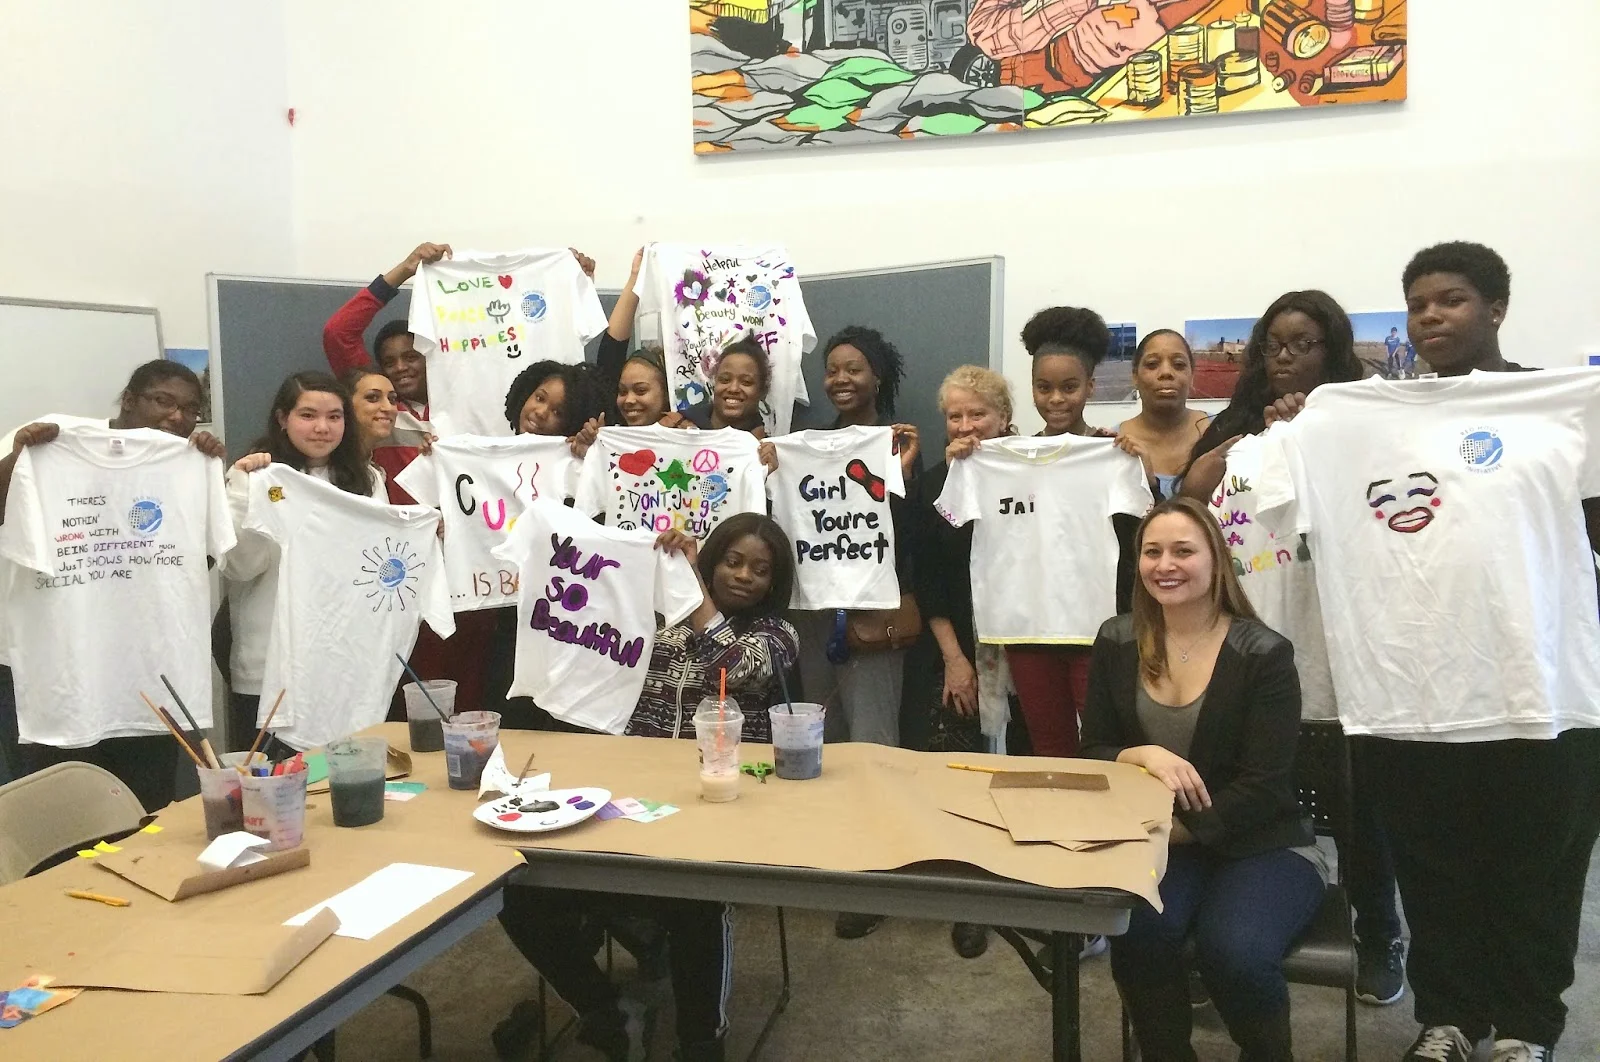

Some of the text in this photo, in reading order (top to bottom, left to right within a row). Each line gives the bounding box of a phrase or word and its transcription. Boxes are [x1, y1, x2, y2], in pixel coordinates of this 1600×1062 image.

[695, 308, 736, 323] Beauty
[798, 474, 847, 502] Girl
[67, 495, 106, 506] THERE'S
[812, 509, 879, 533] You're
[54, 532, 85, 543] WRONG
[89, 528, 119, 537] WITH
[57, 544, 88, 558] BEING
[795, 532, 889, 564] Perfect
[87, 555, 123, 568] SHOWS
[128, 555, 152, 565] HOW
[156, 555, 185, 566] MORE
[89, 570, 105, 580] YOU
[111, 570, 132, 579] ARE
